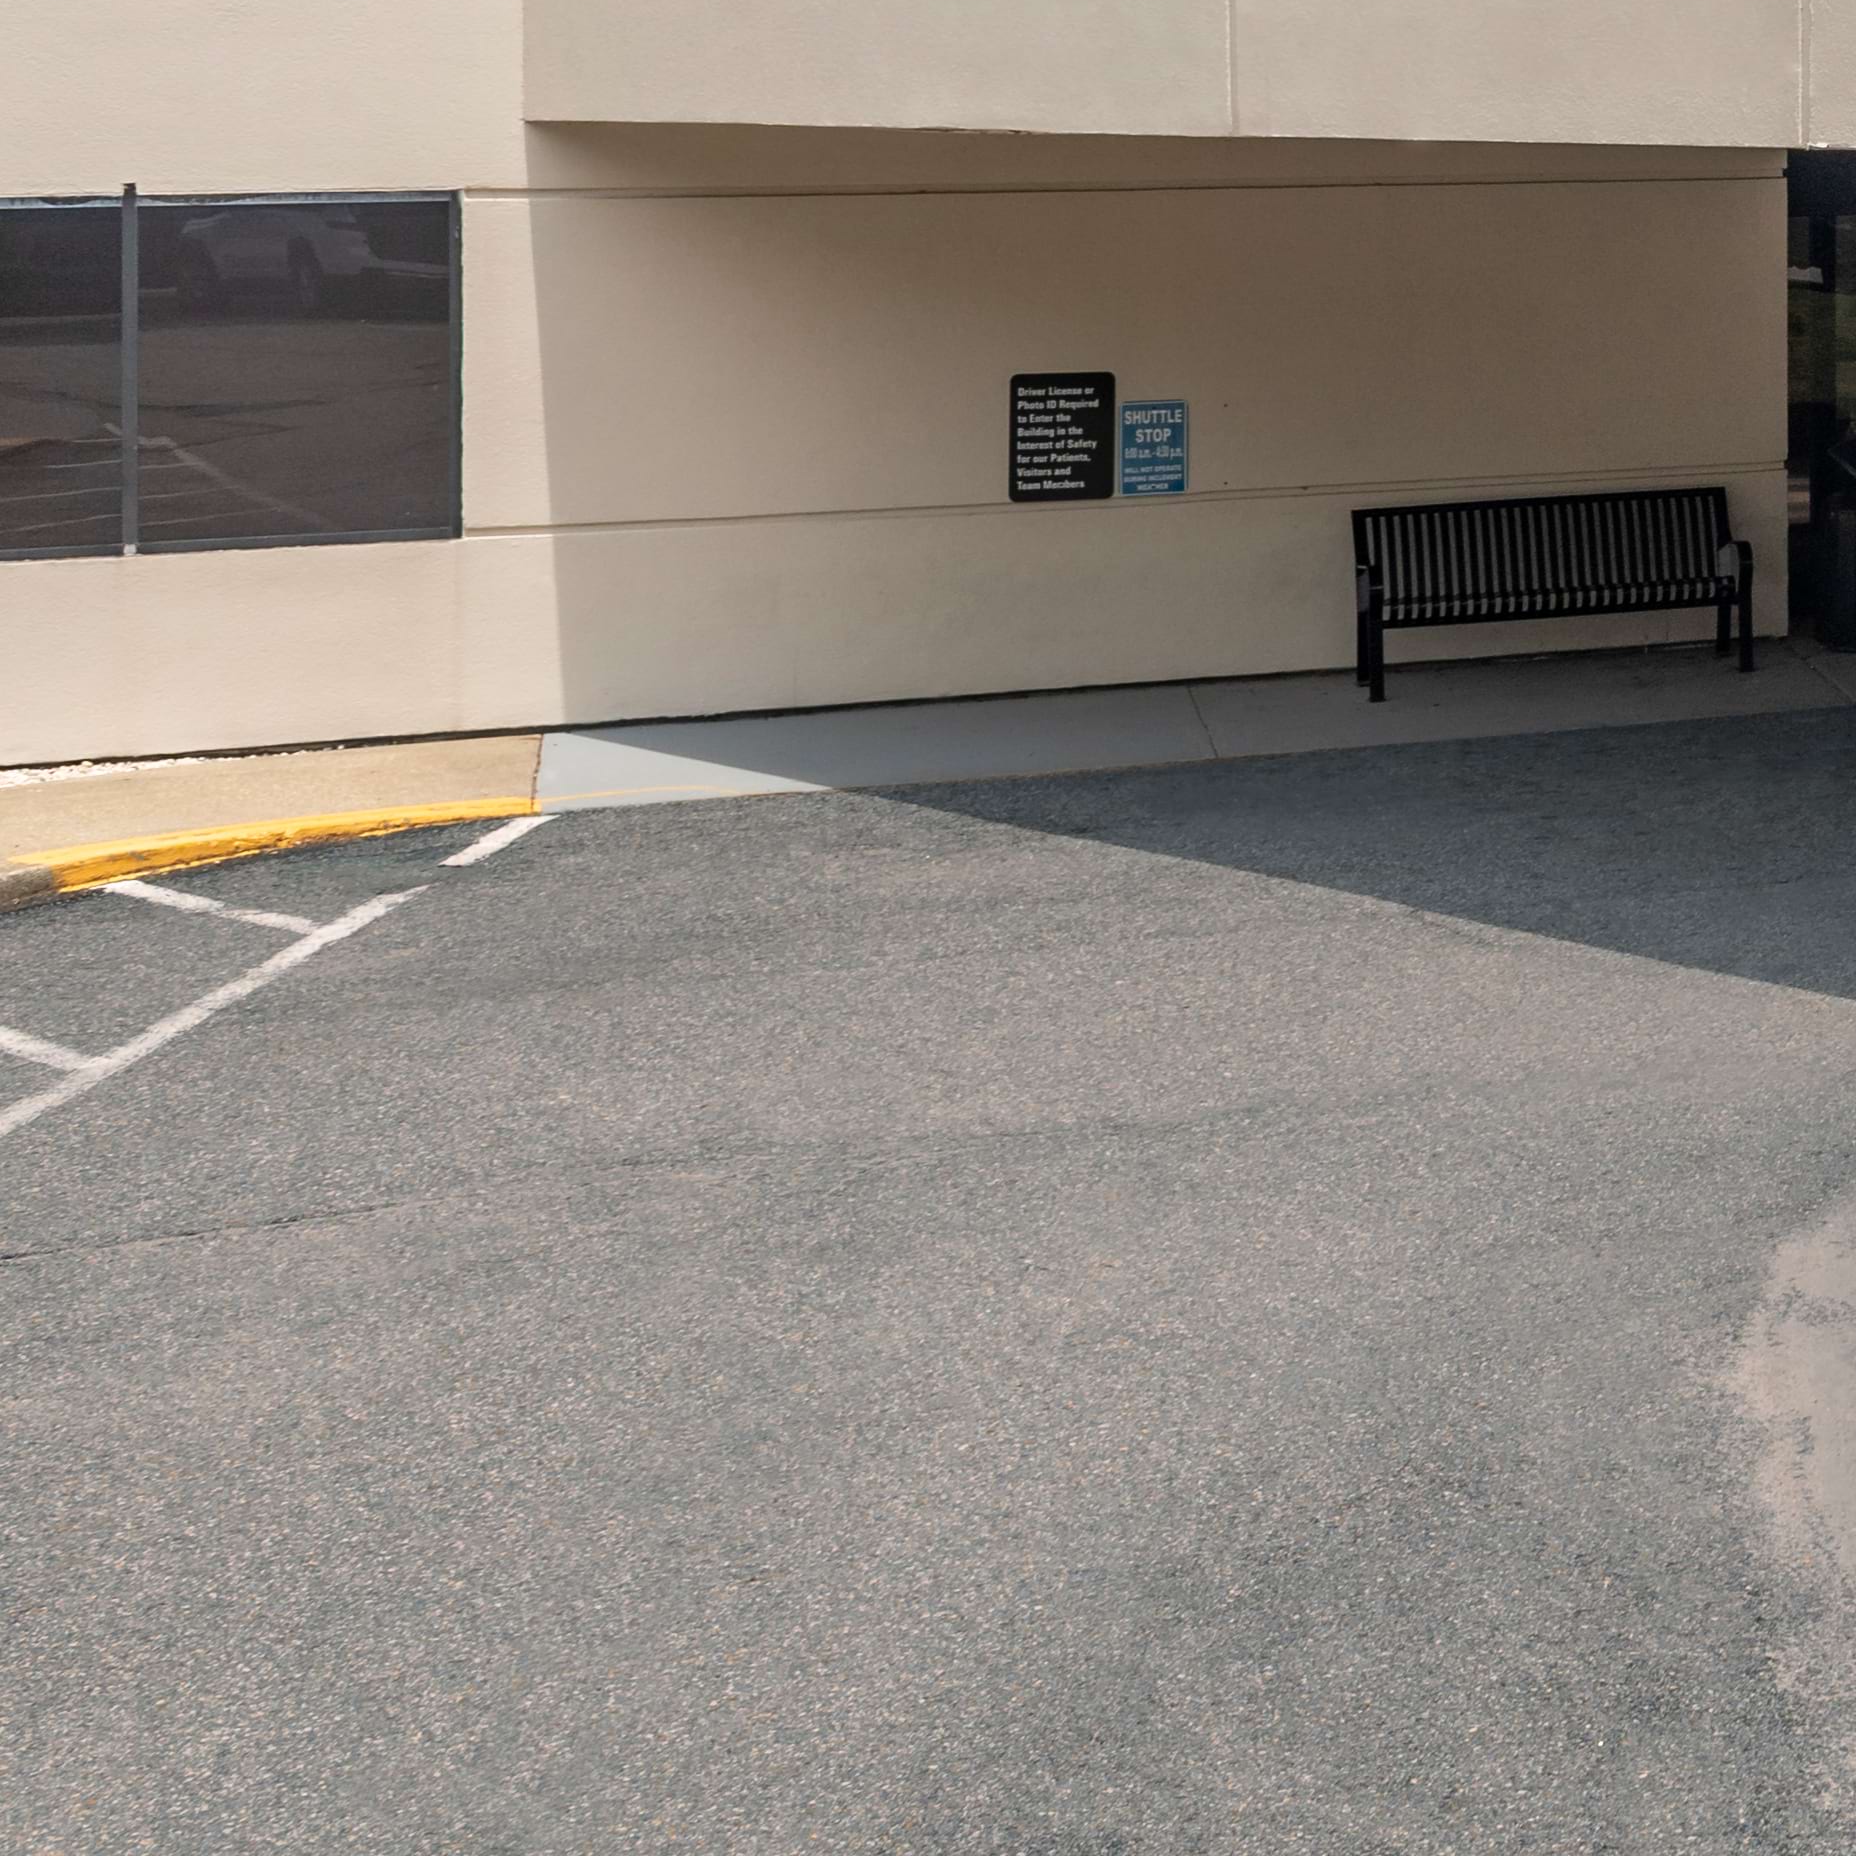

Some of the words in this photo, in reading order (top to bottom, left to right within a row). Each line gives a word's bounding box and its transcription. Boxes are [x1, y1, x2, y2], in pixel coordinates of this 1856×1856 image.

[1017, 387, 1046, 397] Driver
[1048, 386, 1082, 396] License
[1084, 387, 1095, 395] or
[1017, 400, 1045, 410] Photo
[1046, 400, 1057, 409] ID
[1059, 399, 1100, 410] Required
[1017, 414, 1027, 423] to
[1029, 413, 1053, 423] Enter
[1056, 413, 1072, 422] the
[1124, 409, 1183, 425] SHUTTLE
[1017, 426, 1055, 437] Building
[1057, 426, 1066, 435] in
[1068, 426, 1084, 435] the
[1135, 428, 1172, 443] STOP
[1017, 440, 1053, 450] Interest
[1055, 439, 1065, 448] of
[1066, 439, 1098, 449] Safety
[1017, 454, 1031, 463] for
[1032, 455, 1048, 463] our
[1017, 467, 1053, 477] Visitors
[1054, 466, 1072, 476] and
[1017, 481, 1041, 491] Team
[1042, 479, 1086, 489] Members
